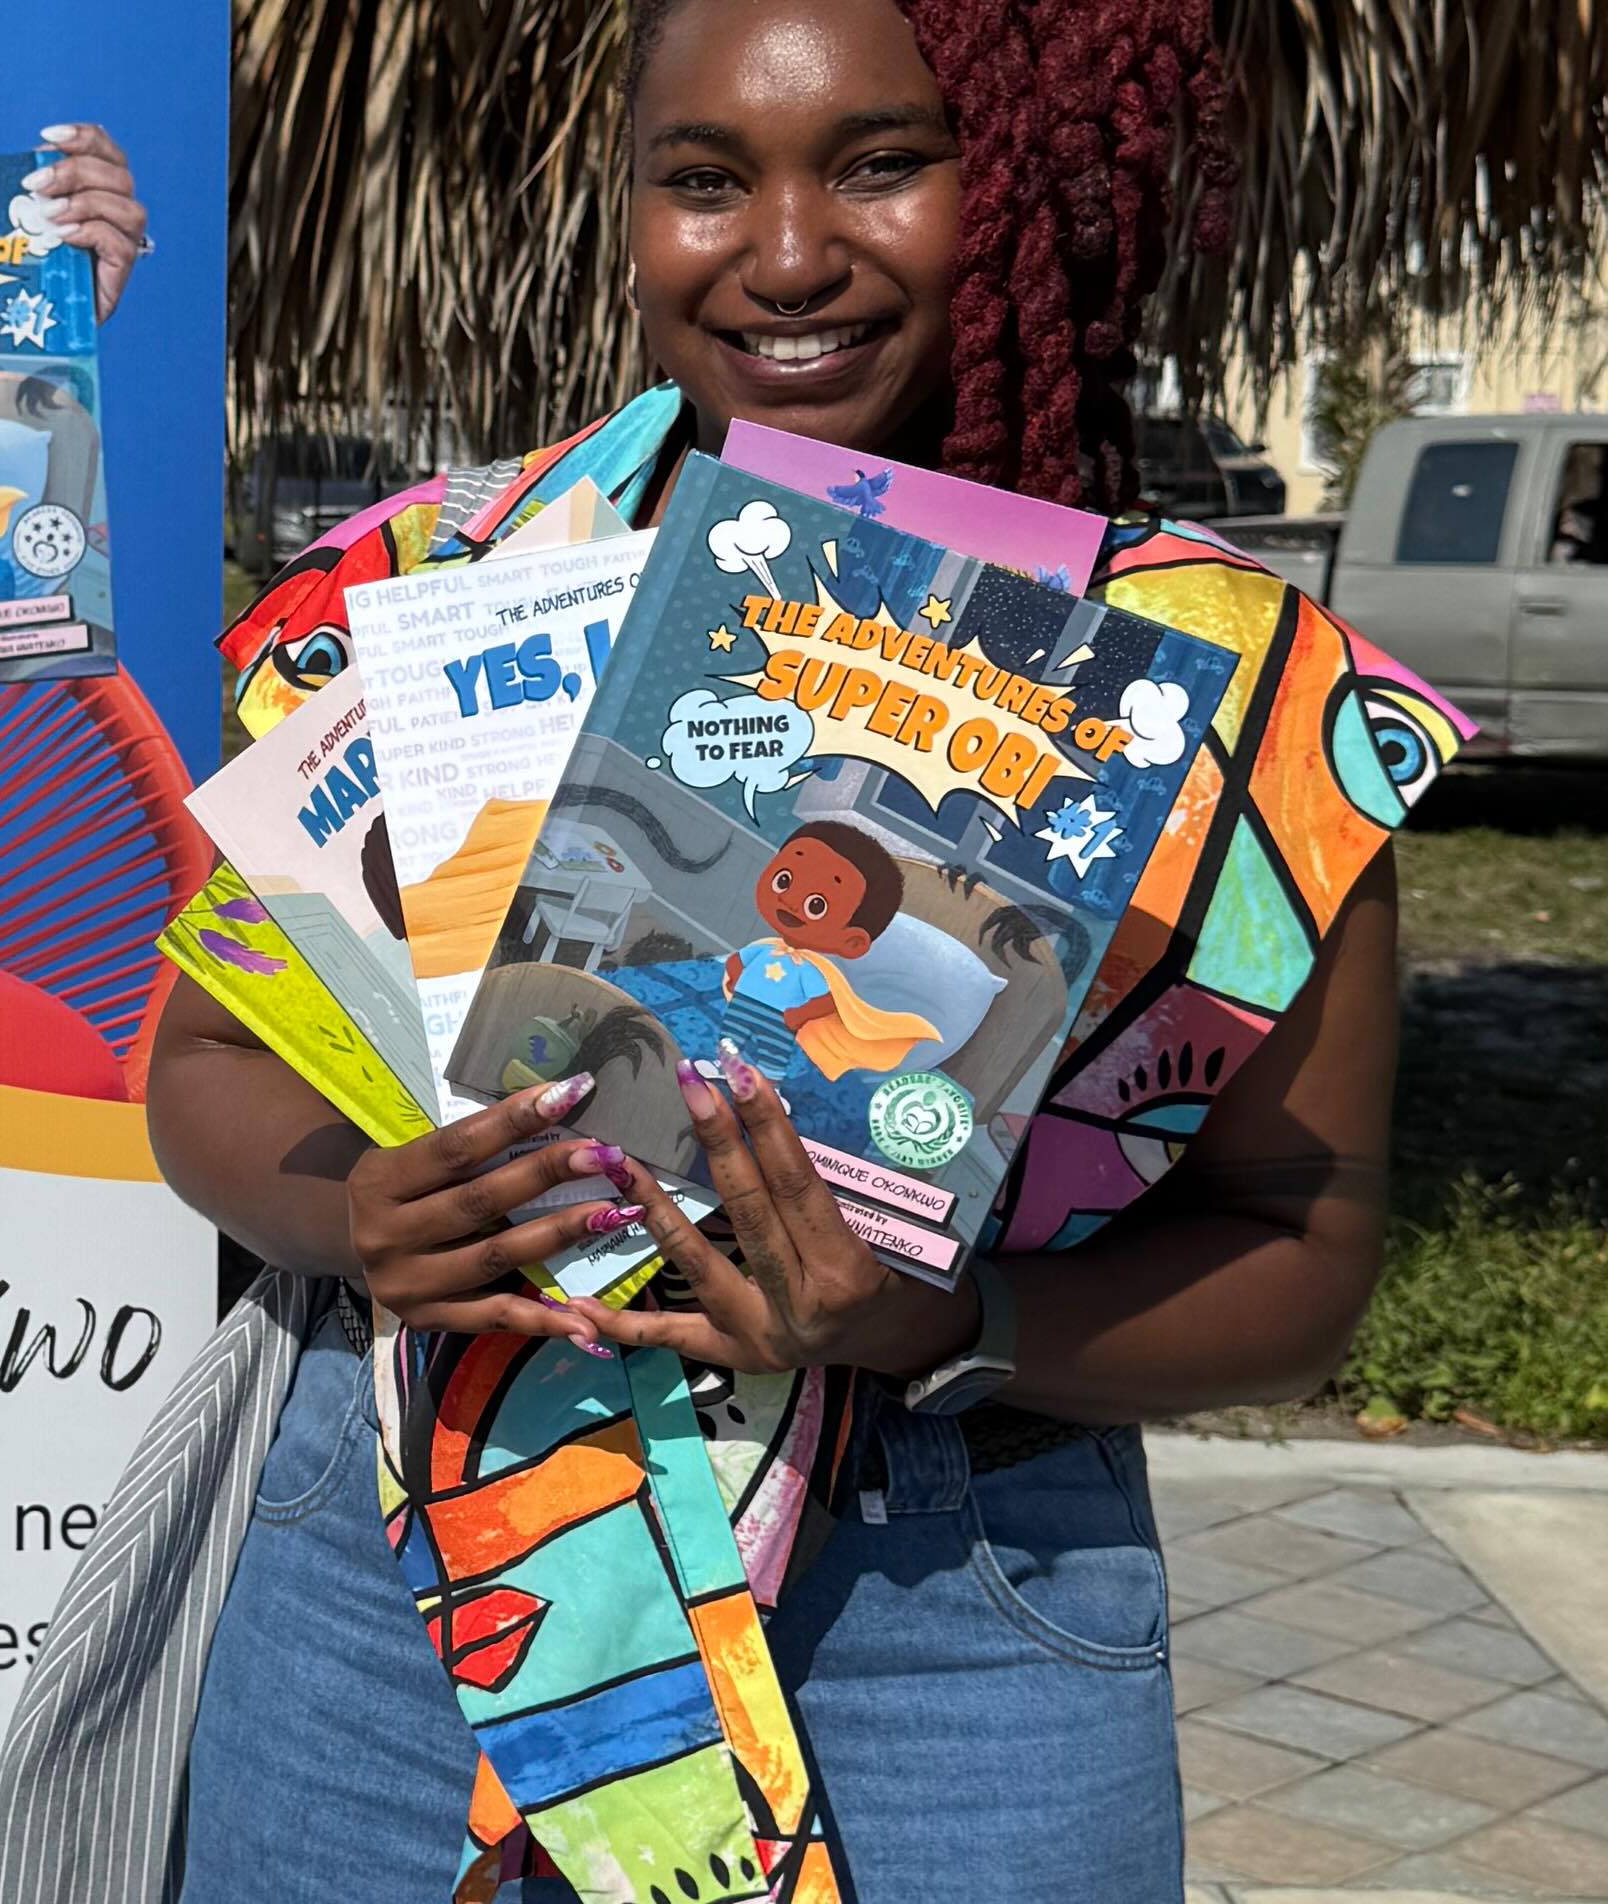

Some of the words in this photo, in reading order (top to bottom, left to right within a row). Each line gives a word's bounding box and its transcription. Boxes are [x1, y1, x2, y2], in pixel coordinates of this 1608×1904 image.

[376, 575, 472, 606] HELPFUL
[477, 566, 533, 588] SMART
[541, 555, 598, 577] TOUGH
[496, 604, 528, 627] THE
[532, 576, 625, 617] ADVENTURES
[629, 572, 642, 589] O
[398, 600, 476, 631] SMART
[393, 632, 446, 654] SMART
[376, 658, 442, 688] TOUG
[443, 633, 582, 718] YES,
[741, 595, 825, 638] THE
[822, 613, 1077, 734] ADVENTURES
[1074, 721, 1135, 763] OF
[428, 736, 467, 753] KIND
[470, 725, 537, 744] STRONG
[687, 713, 790, 739] NOTHING
[755, 649, 949, 755] SUPER
[947, 716, 1064, 811] OBI
[297, 750, 322, 781] THE
[695, 740, 725, 761] TO
[728, 739, 784, 760] FEAR
[398, 762, 459, 789] KIND
[465, 757, 532, 780] STRONG
[1047, 801, 1119, 860] #1
[807, 1150, 869, 1183] OMINIQUE
[871, 1176, 946, 1211] OKONKWO
[16, 1503, 108, 1551] ne
